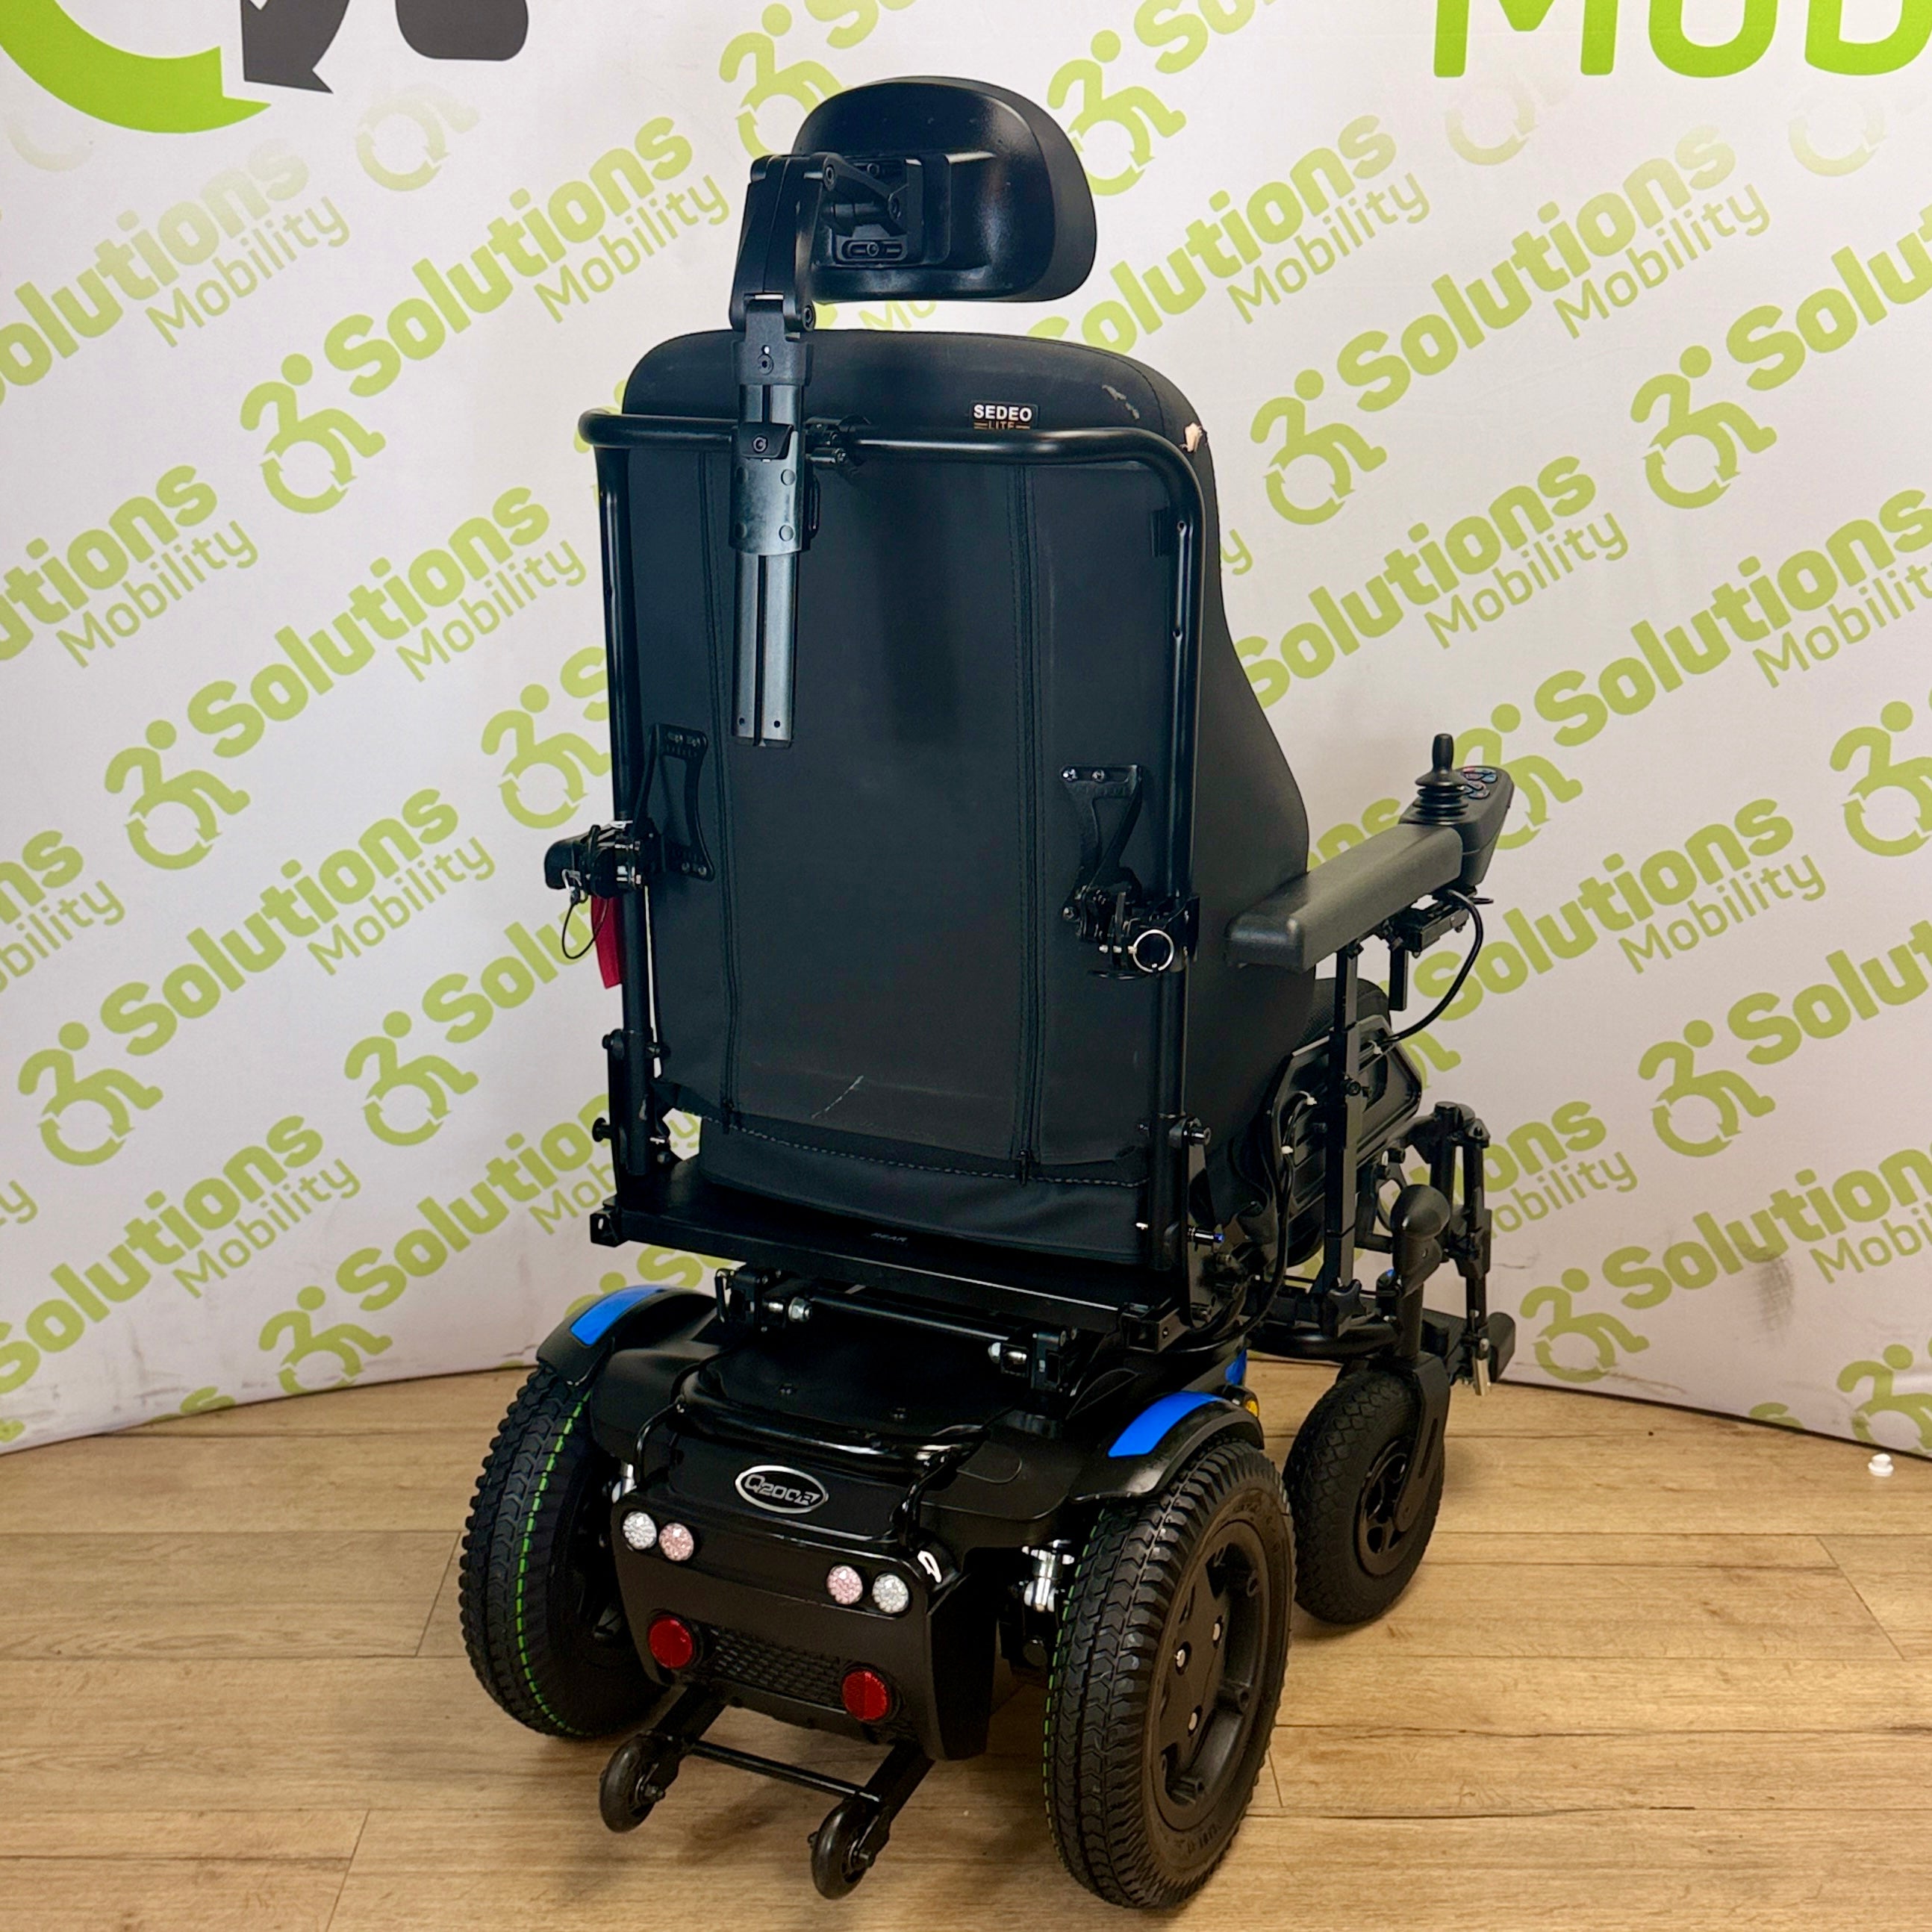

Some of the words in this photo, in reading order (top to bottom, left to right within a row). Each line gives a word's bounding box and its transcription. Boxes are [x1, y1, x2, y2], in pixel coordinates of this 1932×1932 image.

[0, 139, 309, 407] olutions
[146, 196, 350, 347] Mobility
[324, 117, 693, 397] Solutions
[534, 175, 729, 323] Mobility
[1026, 115, 1396, 355] olutions
[1226, 172, 1430, 324] Mobility
[1337, 125, 1736, 411] Solutions
[1552, 184, 1770, 339] Mobility
[973, 404, 1032, 423] SEDEO
[56, 520, 259, 668] Mobility
[187, 487, 551, 758] Solutions
[396, 540, 587, 682] Mobility
[1235, 456, 1596, 708] Solutions
[1424, 512, 1629, 649] Mobility
[1533, 490, 1932, 747] Solutions
[1752, 561, 1932, 688] Mobilit
[0, 880, 125, 993] bility
[100, 788, 459, 1056] Solutions
[307, 837, 496, 976] Mobility
[1413, 798, 1794, 1021] Solutions
[1618, 854, 1826, 973] Mobility
[172, 1159, 361, 1298] Mobility
[1490, 1152, 1638, 1239] obility
[1603, 1142, 1932, 1310] Solution
